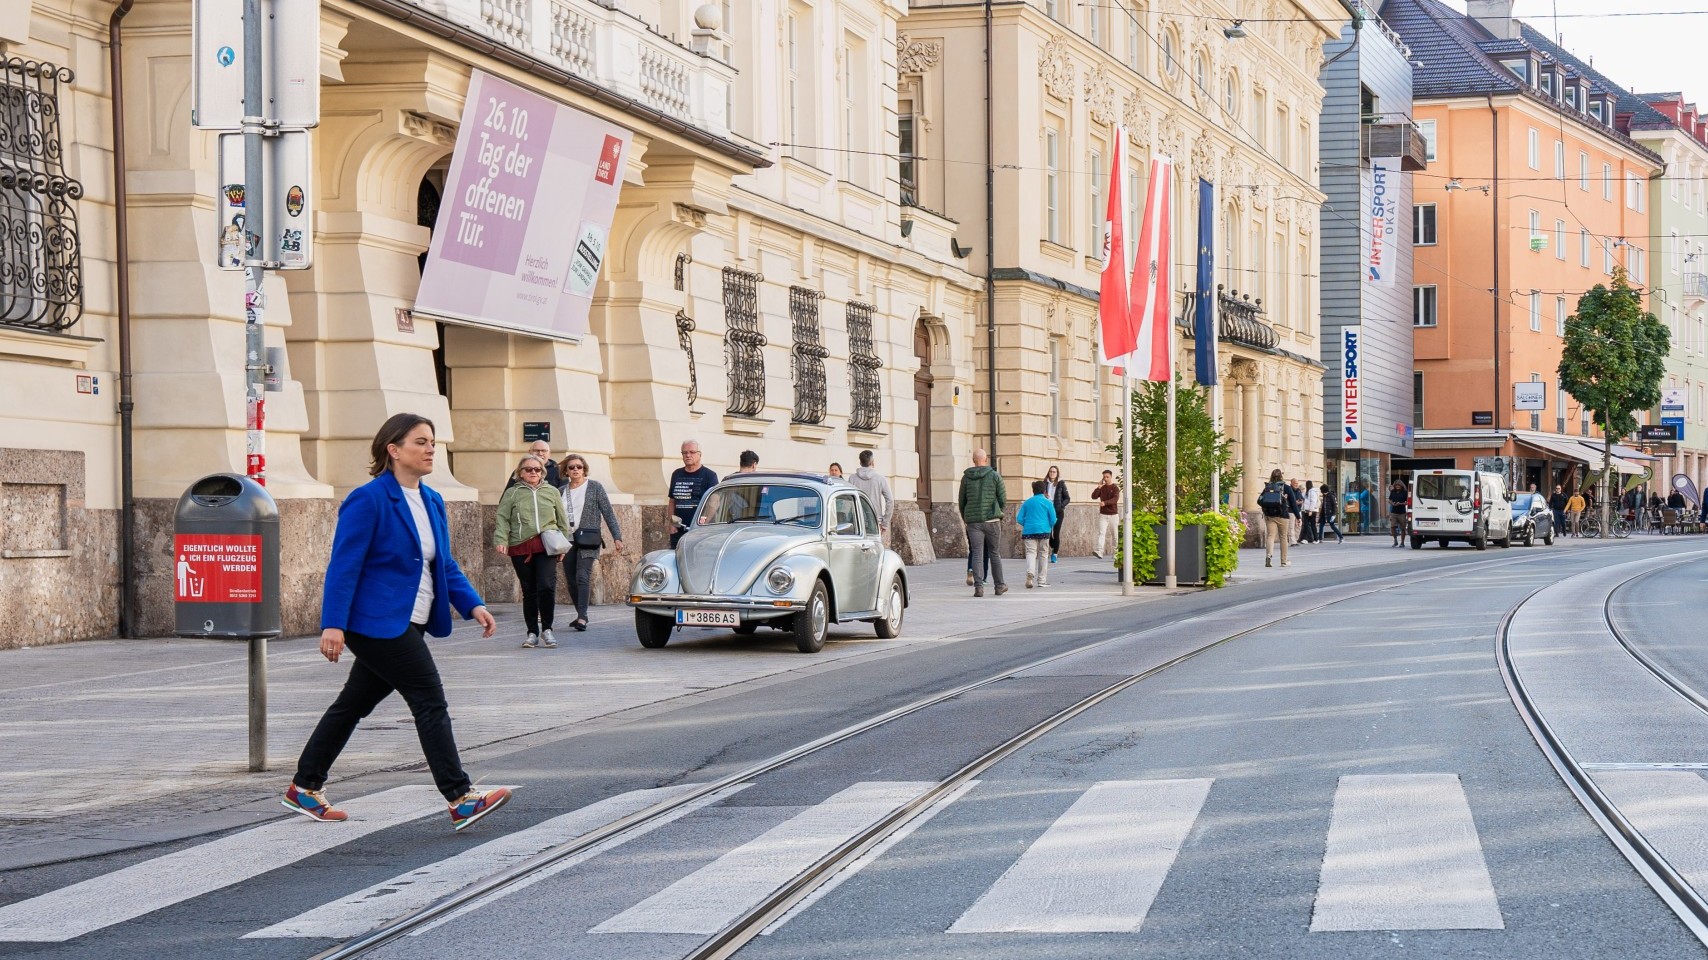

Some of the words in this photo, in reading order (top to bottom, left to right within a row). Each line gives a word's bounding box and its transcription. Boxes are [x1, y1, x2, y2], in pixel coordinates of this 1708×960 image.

[478, 131, 505, 178] Tag
[505, 142, 533, 178] der
[465, 177, 525, 222] offenen
[1370, 164, 1386, 266] INTERSPORT
[1386, 199, 1396, 235] OKAY
[457, 211, 484, 249] Tür.
[525, 254, 549, 270] Herzlich
[522, 270, 558, 288] willkommen!
[1345, 331, 1357, 424] INTERSPORT
[183, 544, 223, 552] EIGENTLICH
[225, 545, 257, 553] WOLLTE
[189, 554, 201, 562] ICH
[222, 564, 257, 572] WERDEN
[696, 612, 720, 623] 3866
[722, 613, 735, 624] AS
